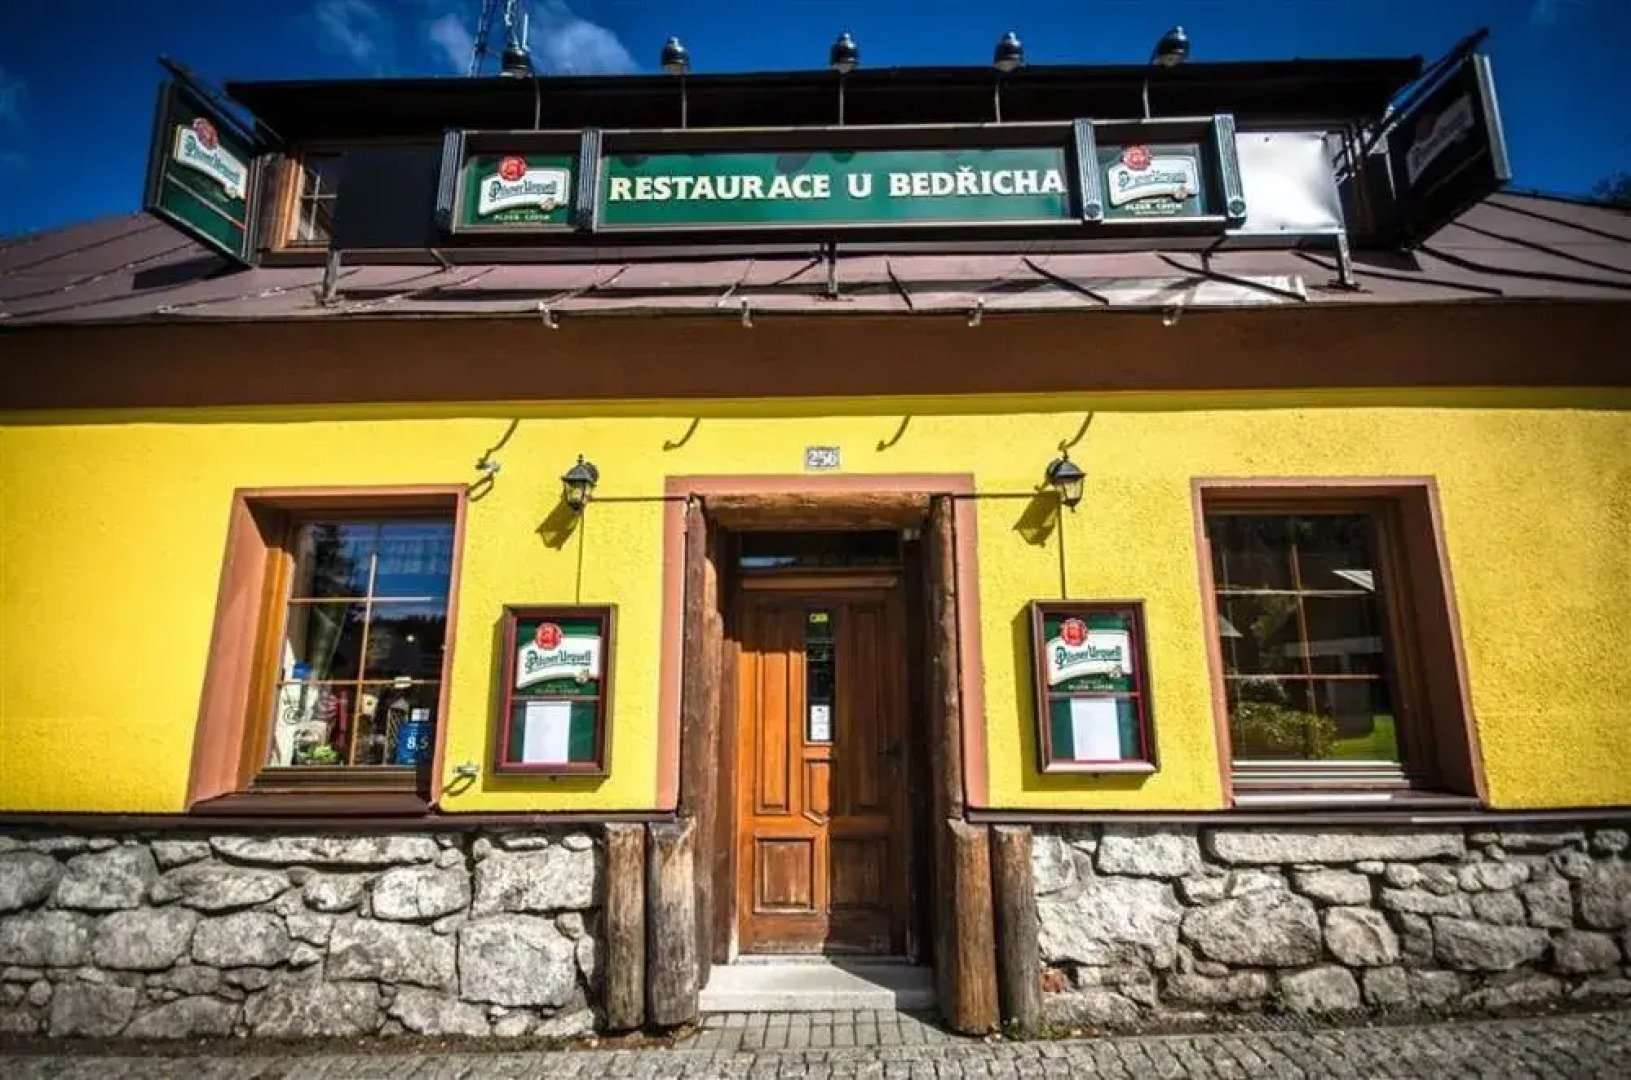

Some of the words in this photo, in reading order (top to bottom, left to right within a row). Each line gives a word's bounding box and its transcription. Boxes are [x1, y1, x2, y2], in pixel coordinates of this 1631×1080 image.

[609, 174, 831, 200] RESTAURACE
[847, 173, 872, 197] U
[888, 165, 1066, 197] BEDŘICHA
